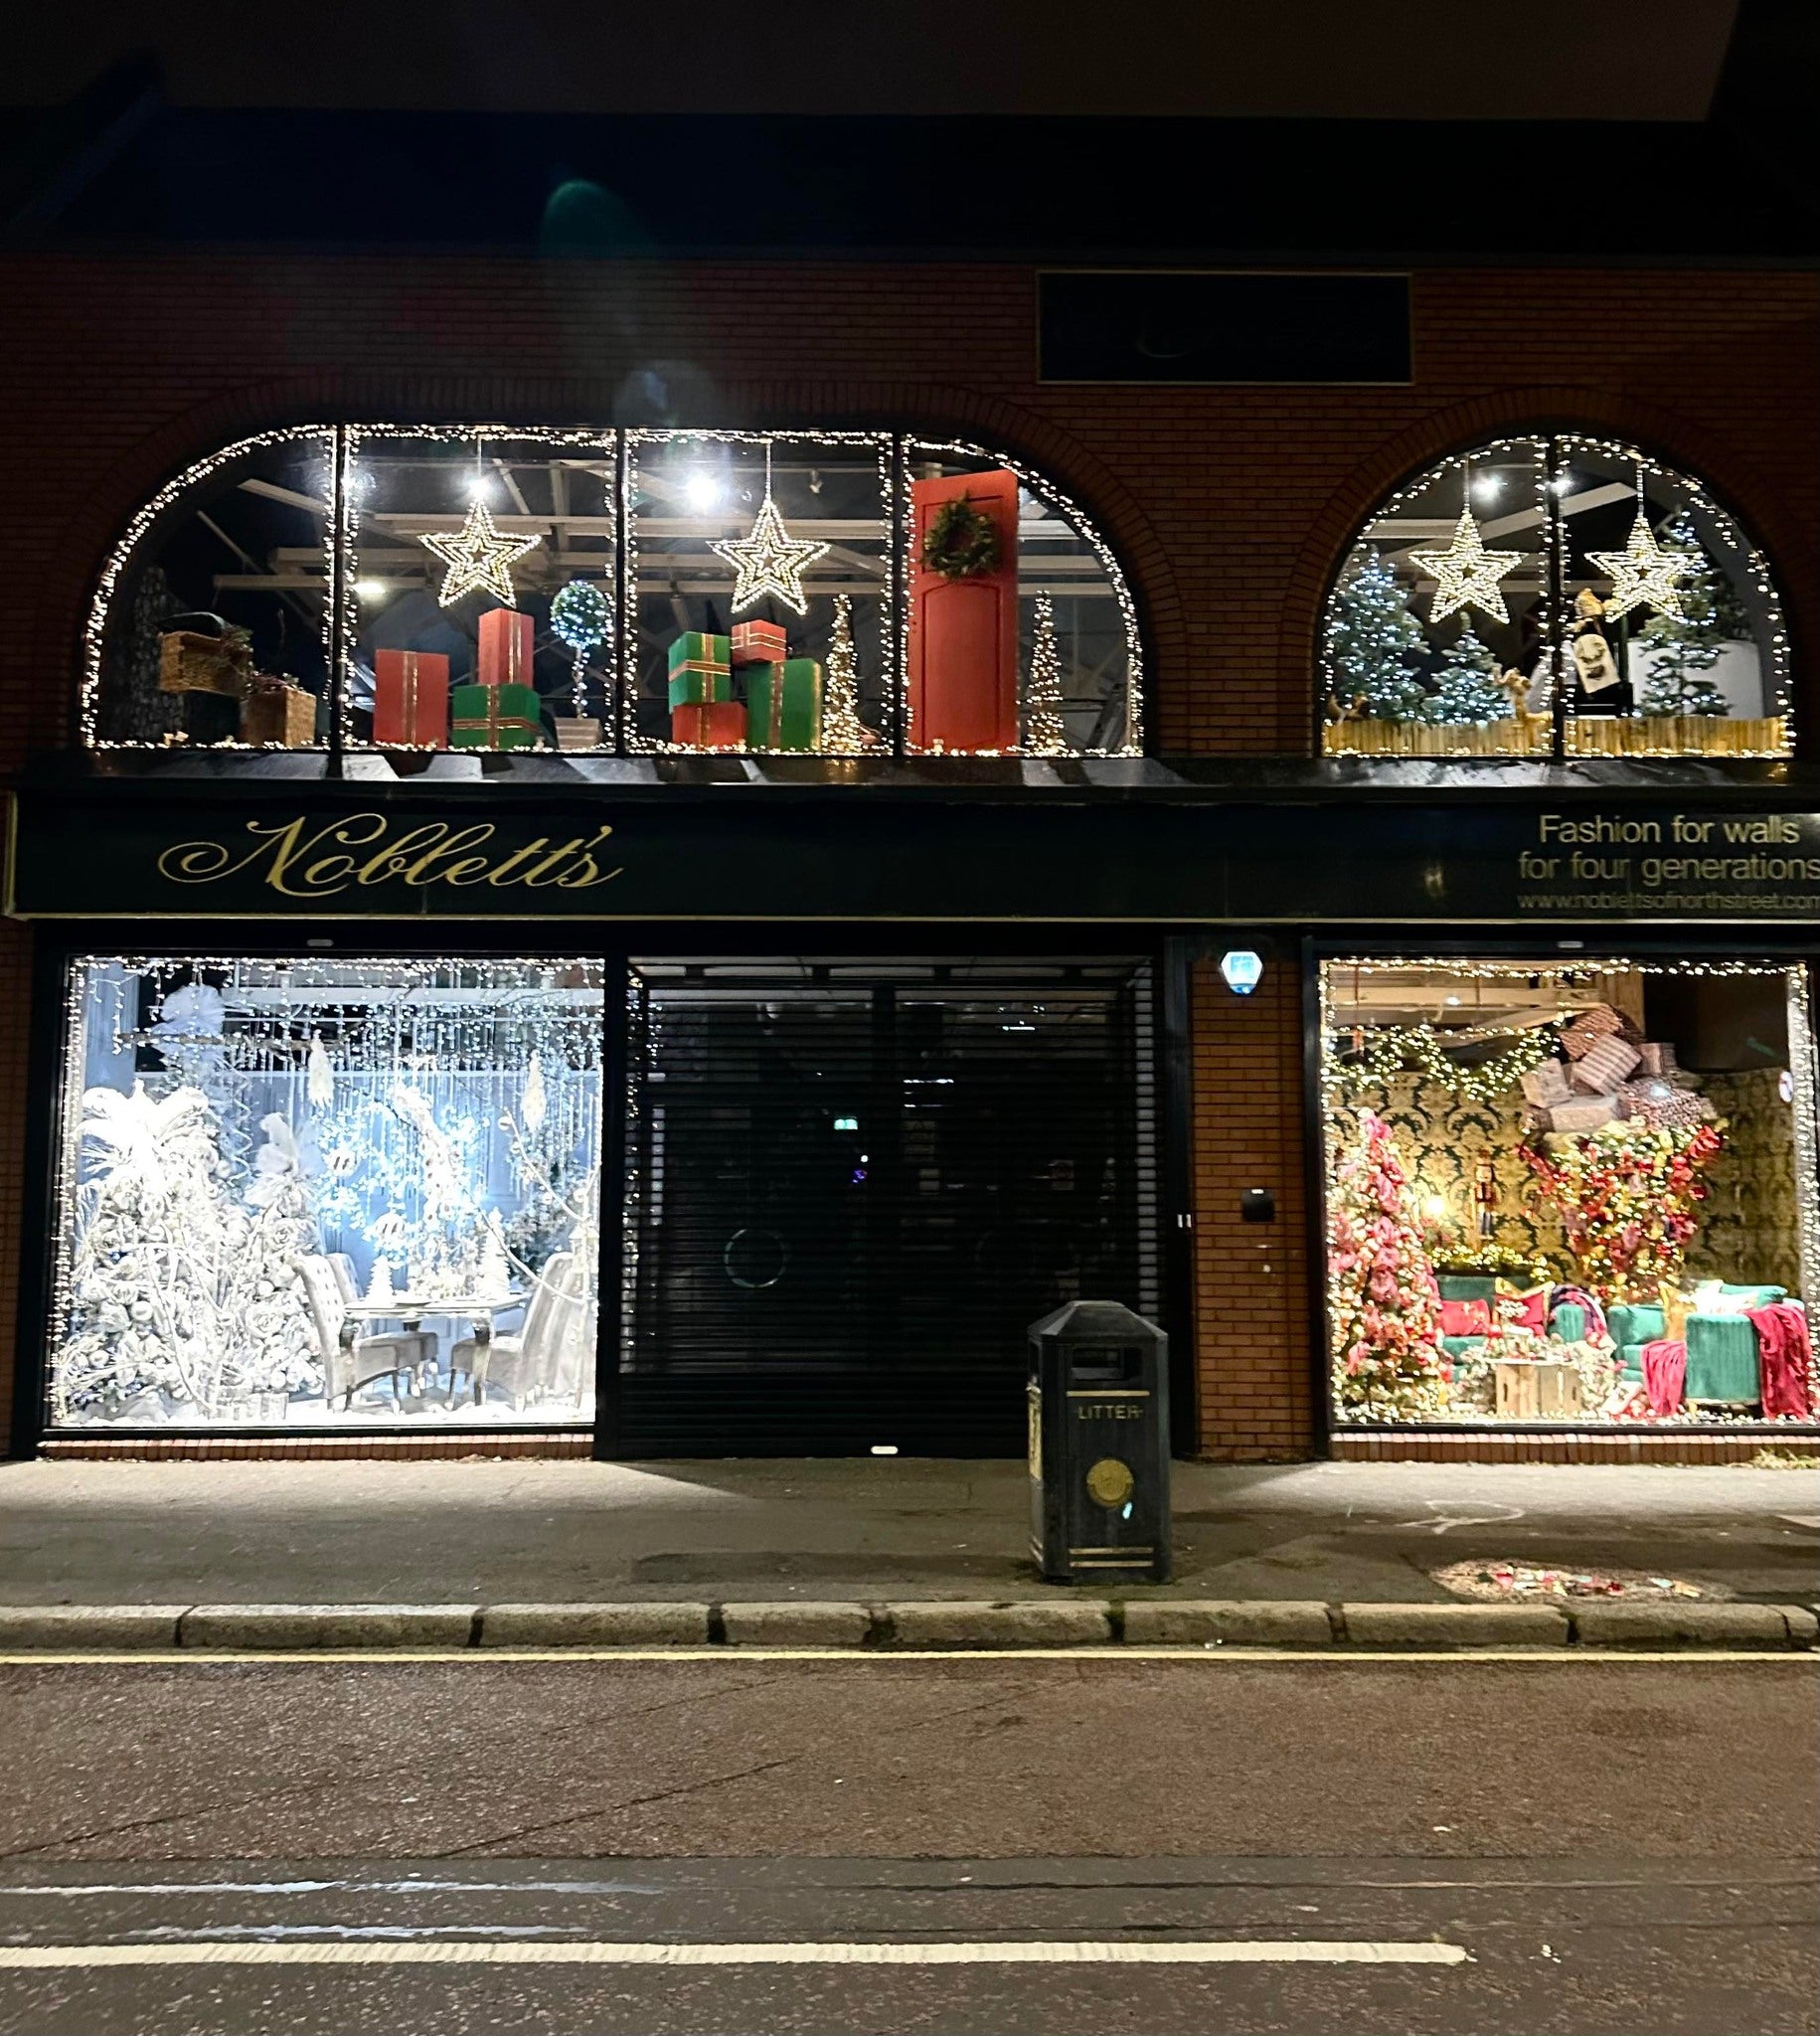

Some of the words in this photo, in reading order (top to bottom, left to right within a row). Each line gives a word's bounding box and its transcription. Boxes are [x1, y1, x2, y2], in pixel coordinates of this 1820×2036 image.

[1540, 814, 1661, 843] Fashion
[1672, 814, 1715, 843] for
[1723, 815, 1800, 844] walls
[157, 812, 624, 898] Noblett's
[1518, 851, 1561, 880] for
[1571, 851, 1631, 881] four
[1640, 852, 1820, 888] generations
[1078, 1405, 1139, 1420] LITTER
